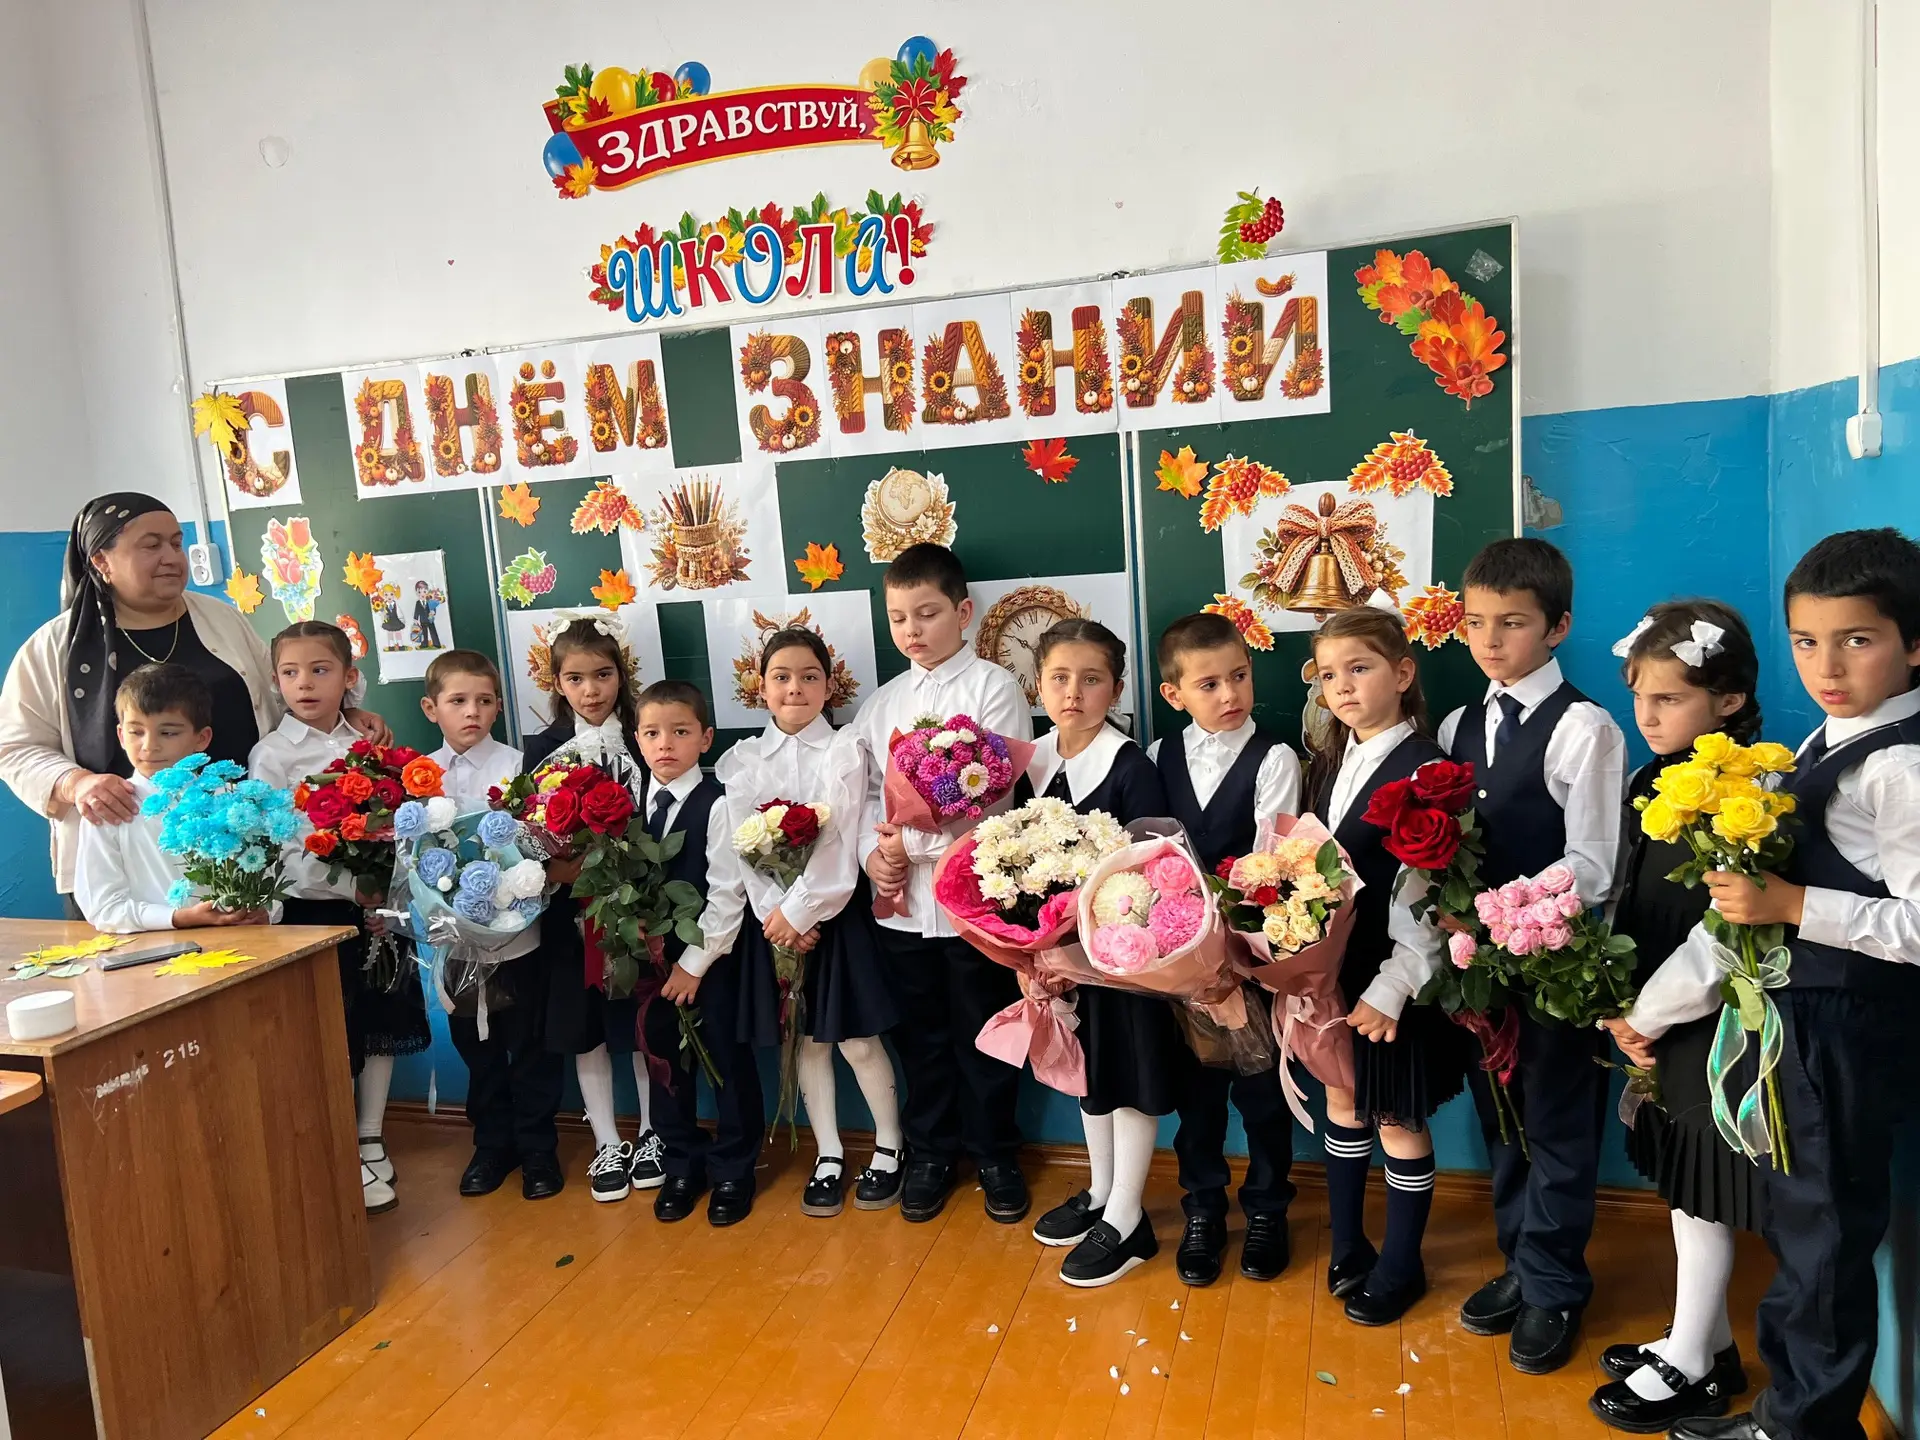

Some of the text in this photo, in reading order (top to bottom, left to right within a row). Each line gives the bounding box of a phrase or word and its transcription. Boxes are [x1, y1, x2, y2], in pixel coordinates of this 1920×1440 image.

[598, 97, 867, 175] ЗДРАВСТВУЙ,
[223, 270, 1327, 498] С ДНЁМ ЗНАНИЙ
[163, 1040, 200, 1068] 215
